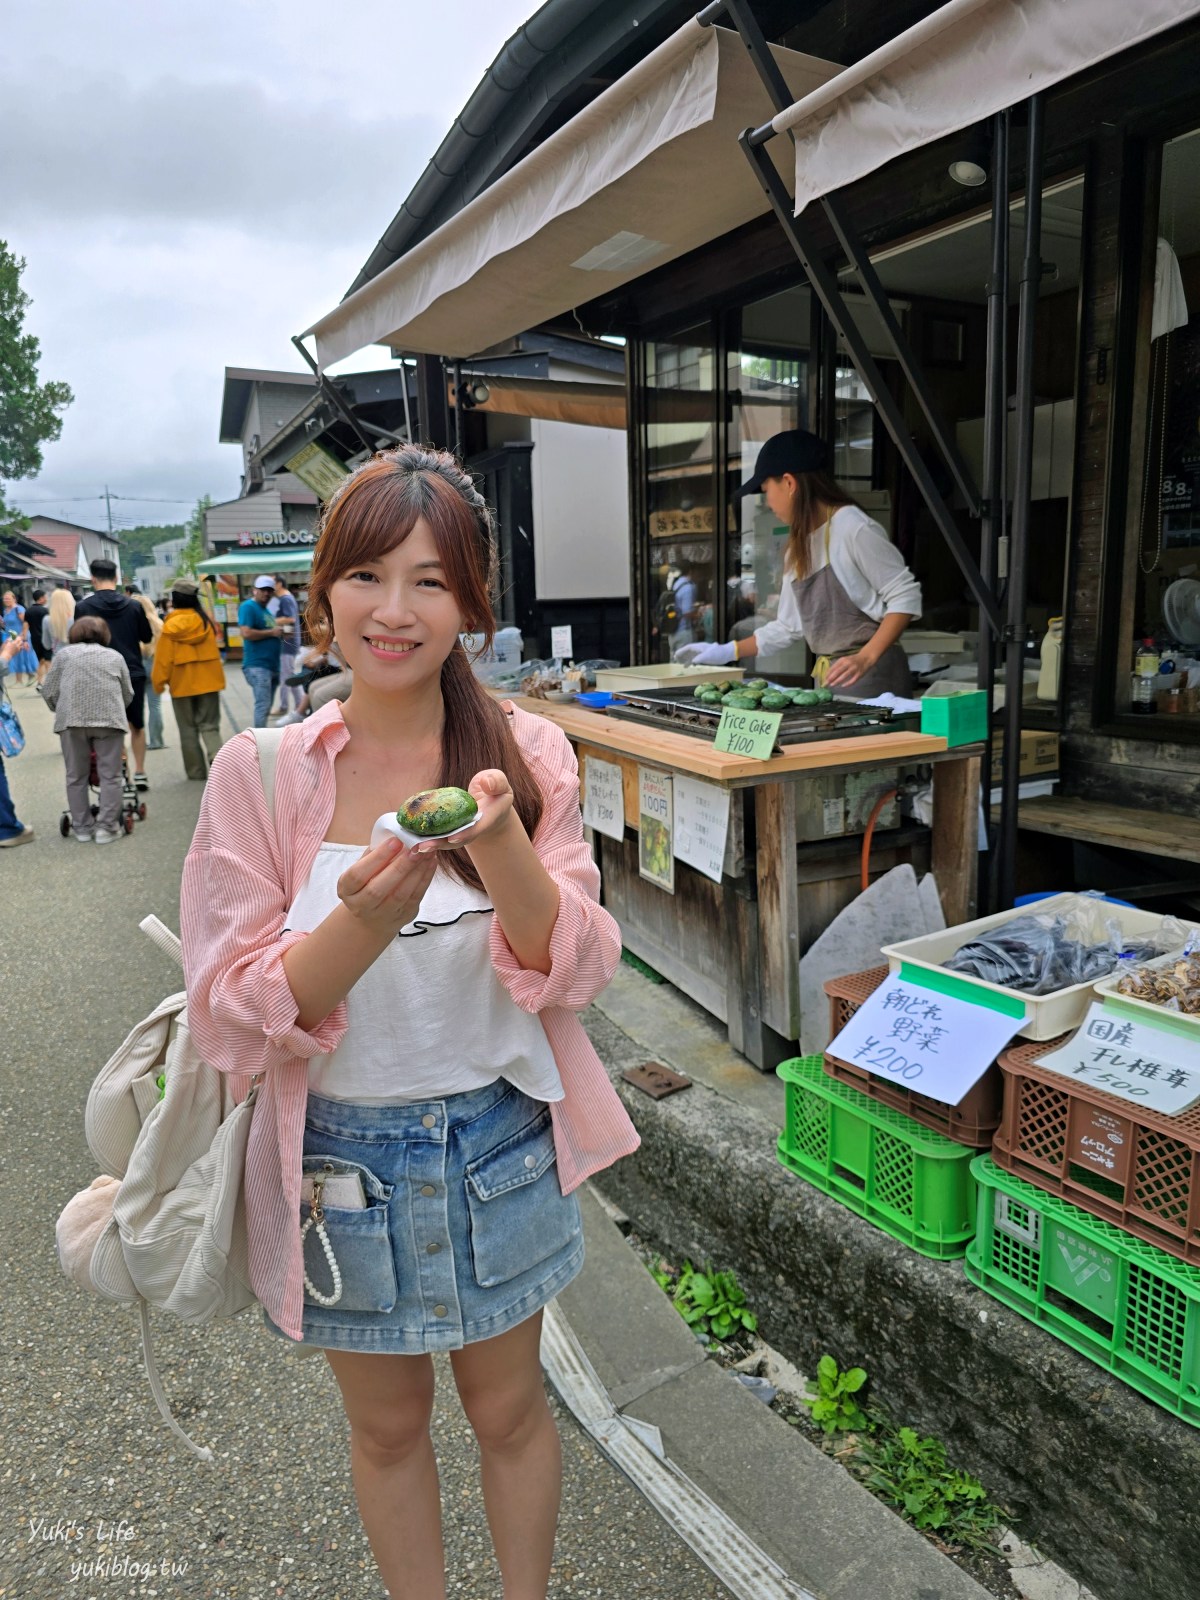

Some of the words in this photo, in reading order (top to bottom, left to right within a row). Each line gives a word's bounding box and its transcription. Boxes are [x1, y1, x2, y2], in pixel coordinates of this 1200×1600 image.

[723, 712, 746, 729] rice
[727, 733, 754, 753] ¥100
[643, 794, 668, 817] 100円
[881, 988, 943, 1021] 朝どれ
[886, 1017, 949, 1054] 野菜
[1087, 1019, 1136, 1048] 国産
[852, 1035, 924, 1080] ¥200
[1090, 1046, 1193, 1089] 干し椎茸
[1072, 1061, 1150, 1096] ¥500
